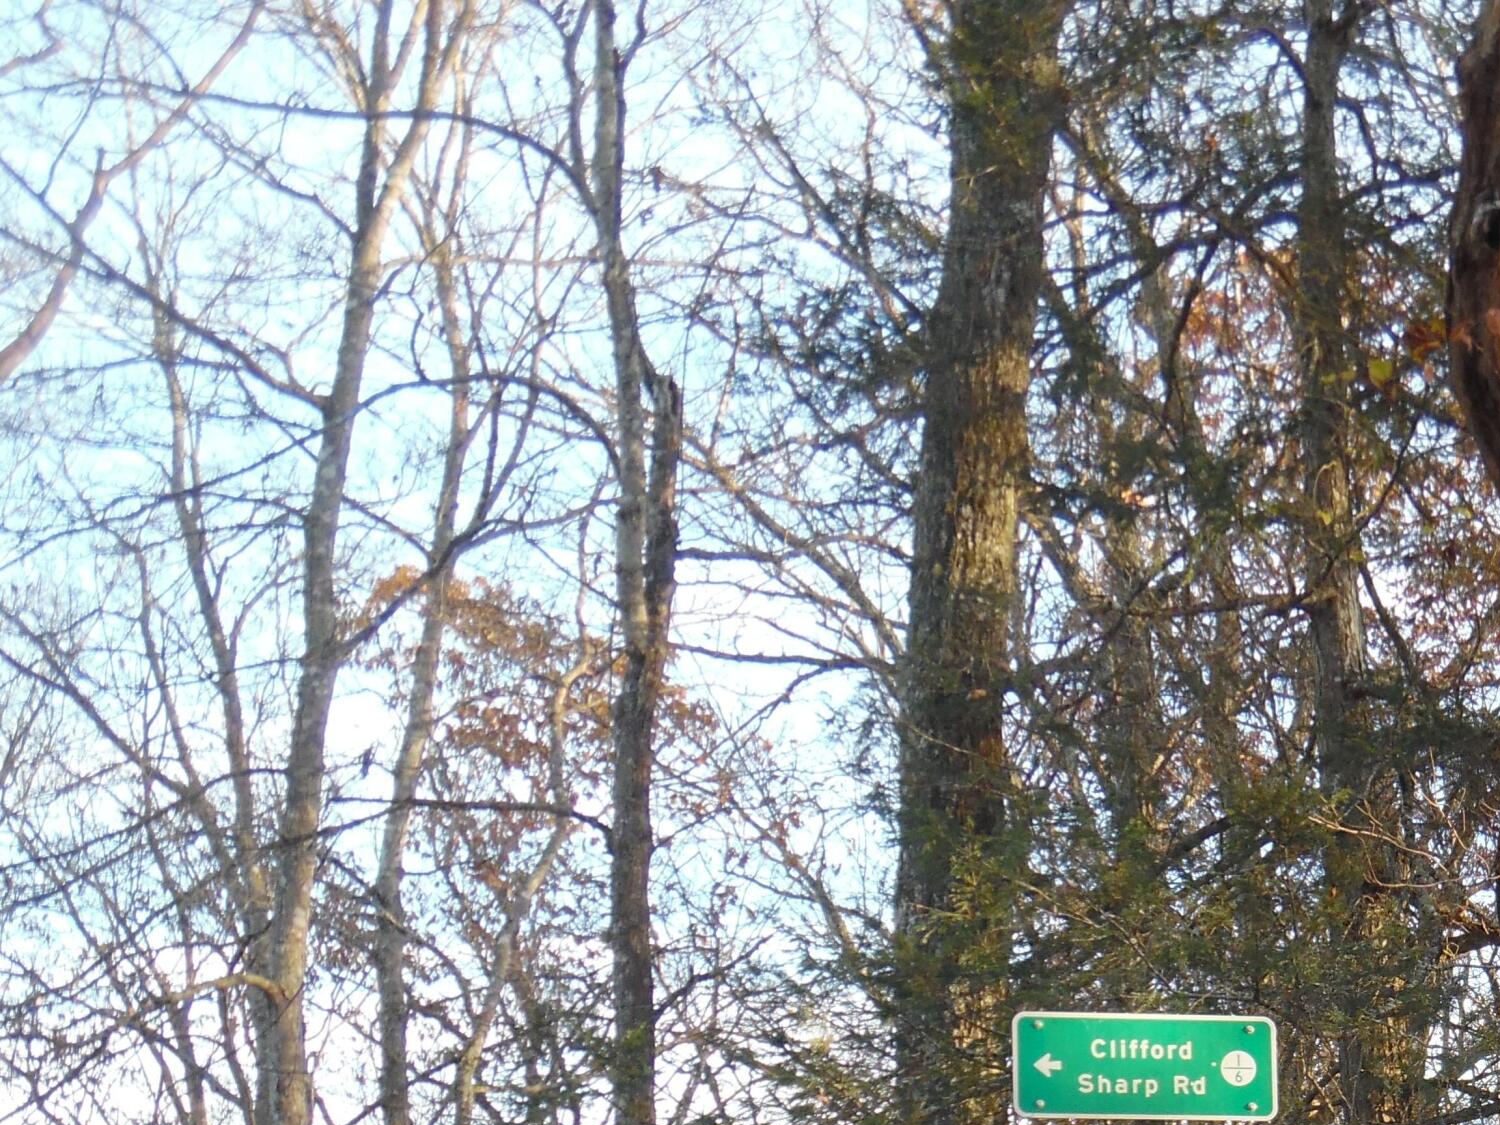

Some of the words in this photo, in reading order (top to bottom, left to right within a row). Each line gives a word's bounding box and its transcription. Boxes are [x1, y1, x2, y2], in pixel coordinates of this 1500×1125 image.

[1090, 1038, 1193, 1060] Clifford
[1077, 1073, 1159, 1098] Sharp
[1173, 1075, 1207, 1095] Rd
[1234, 1070, 1243, 1084] 6
